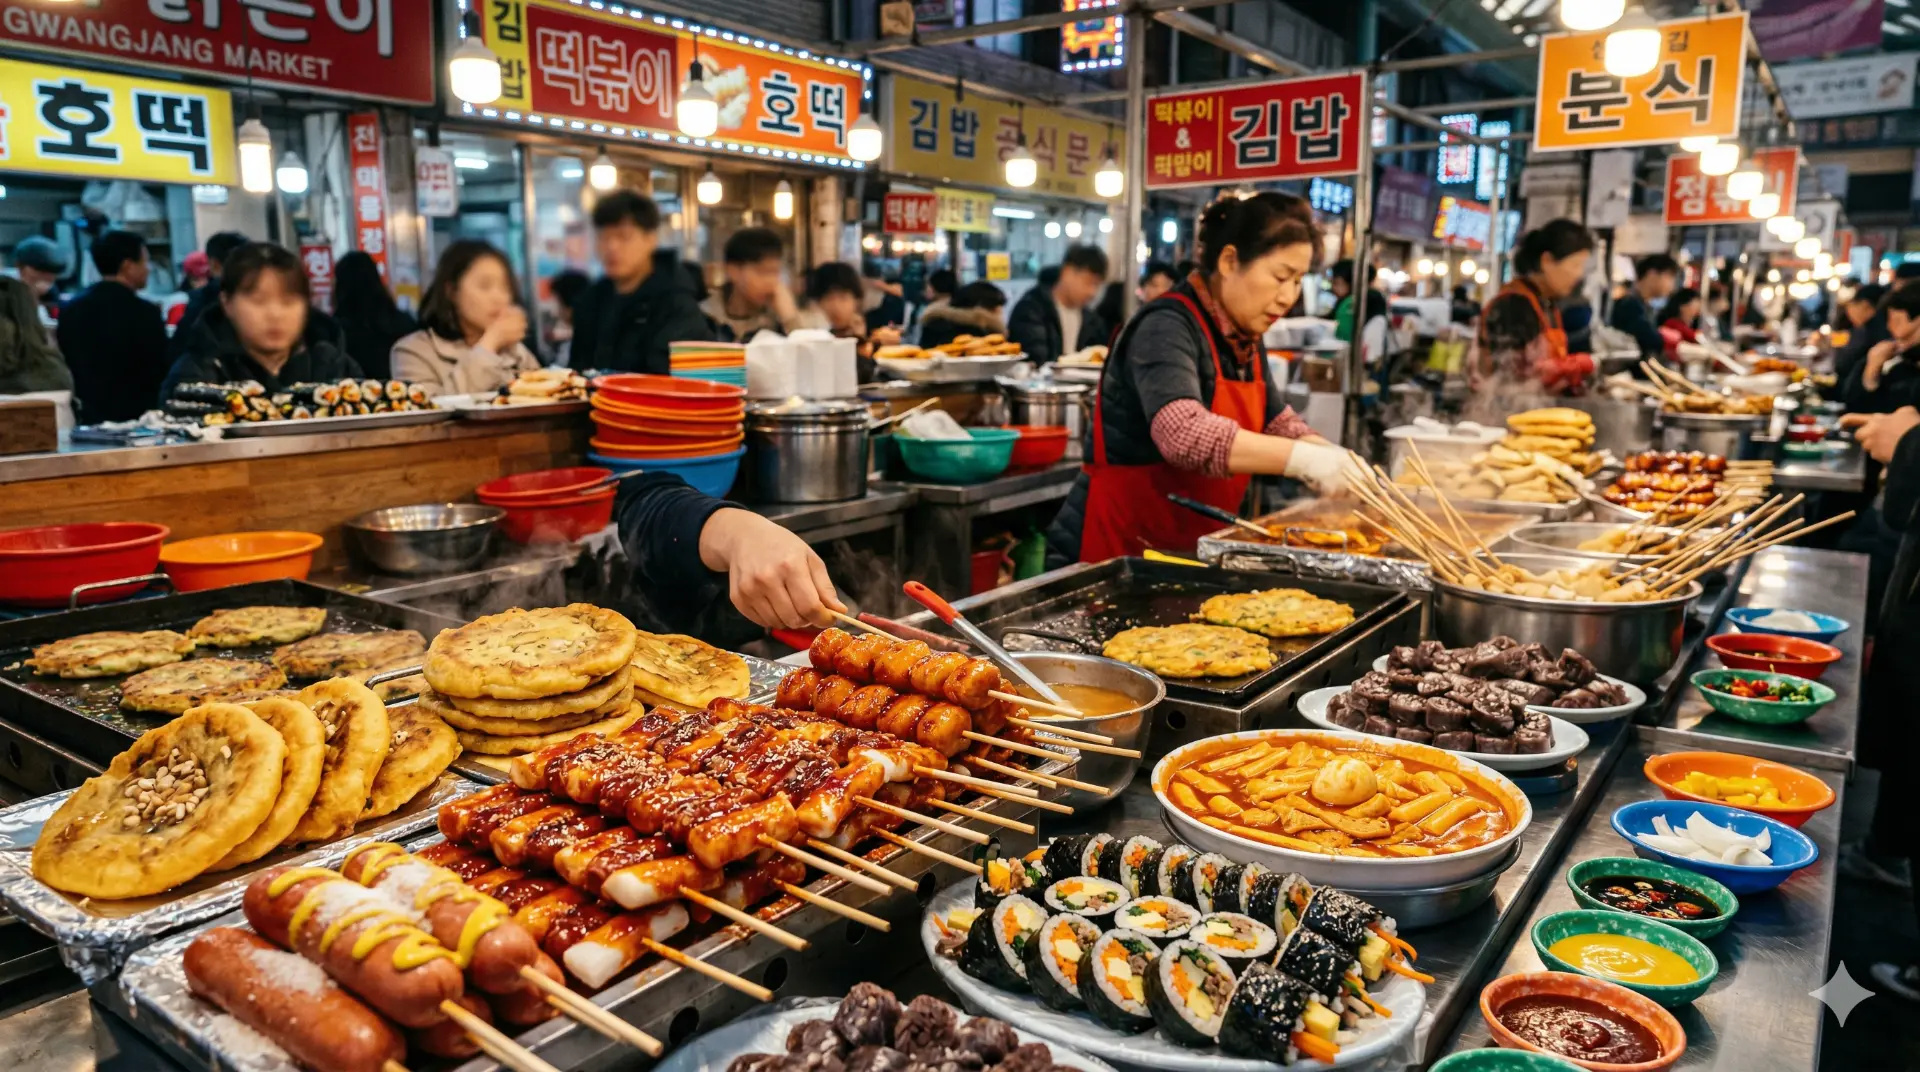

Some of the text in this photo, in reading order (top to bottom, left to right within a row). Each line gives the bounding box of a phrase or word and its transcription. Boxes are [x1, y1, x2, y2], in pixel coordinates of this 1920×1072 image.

[4, 7, 214, 64] GWANGJANG
[223, 43, 333, 81] MARKET
[493, 0, 526, 99] 김밥
[536, 27, 672, 118] 떡볶이
[34, 79, 212, 174] 호떡
[758, 70, 846, 148] 호떡
[909, 98, 980, 160] 김밥
[1228, 93, 1350, 169] 김밥
[1559, 55, 1714, 133] 분식
[1175, 127, 1191, 149] &
